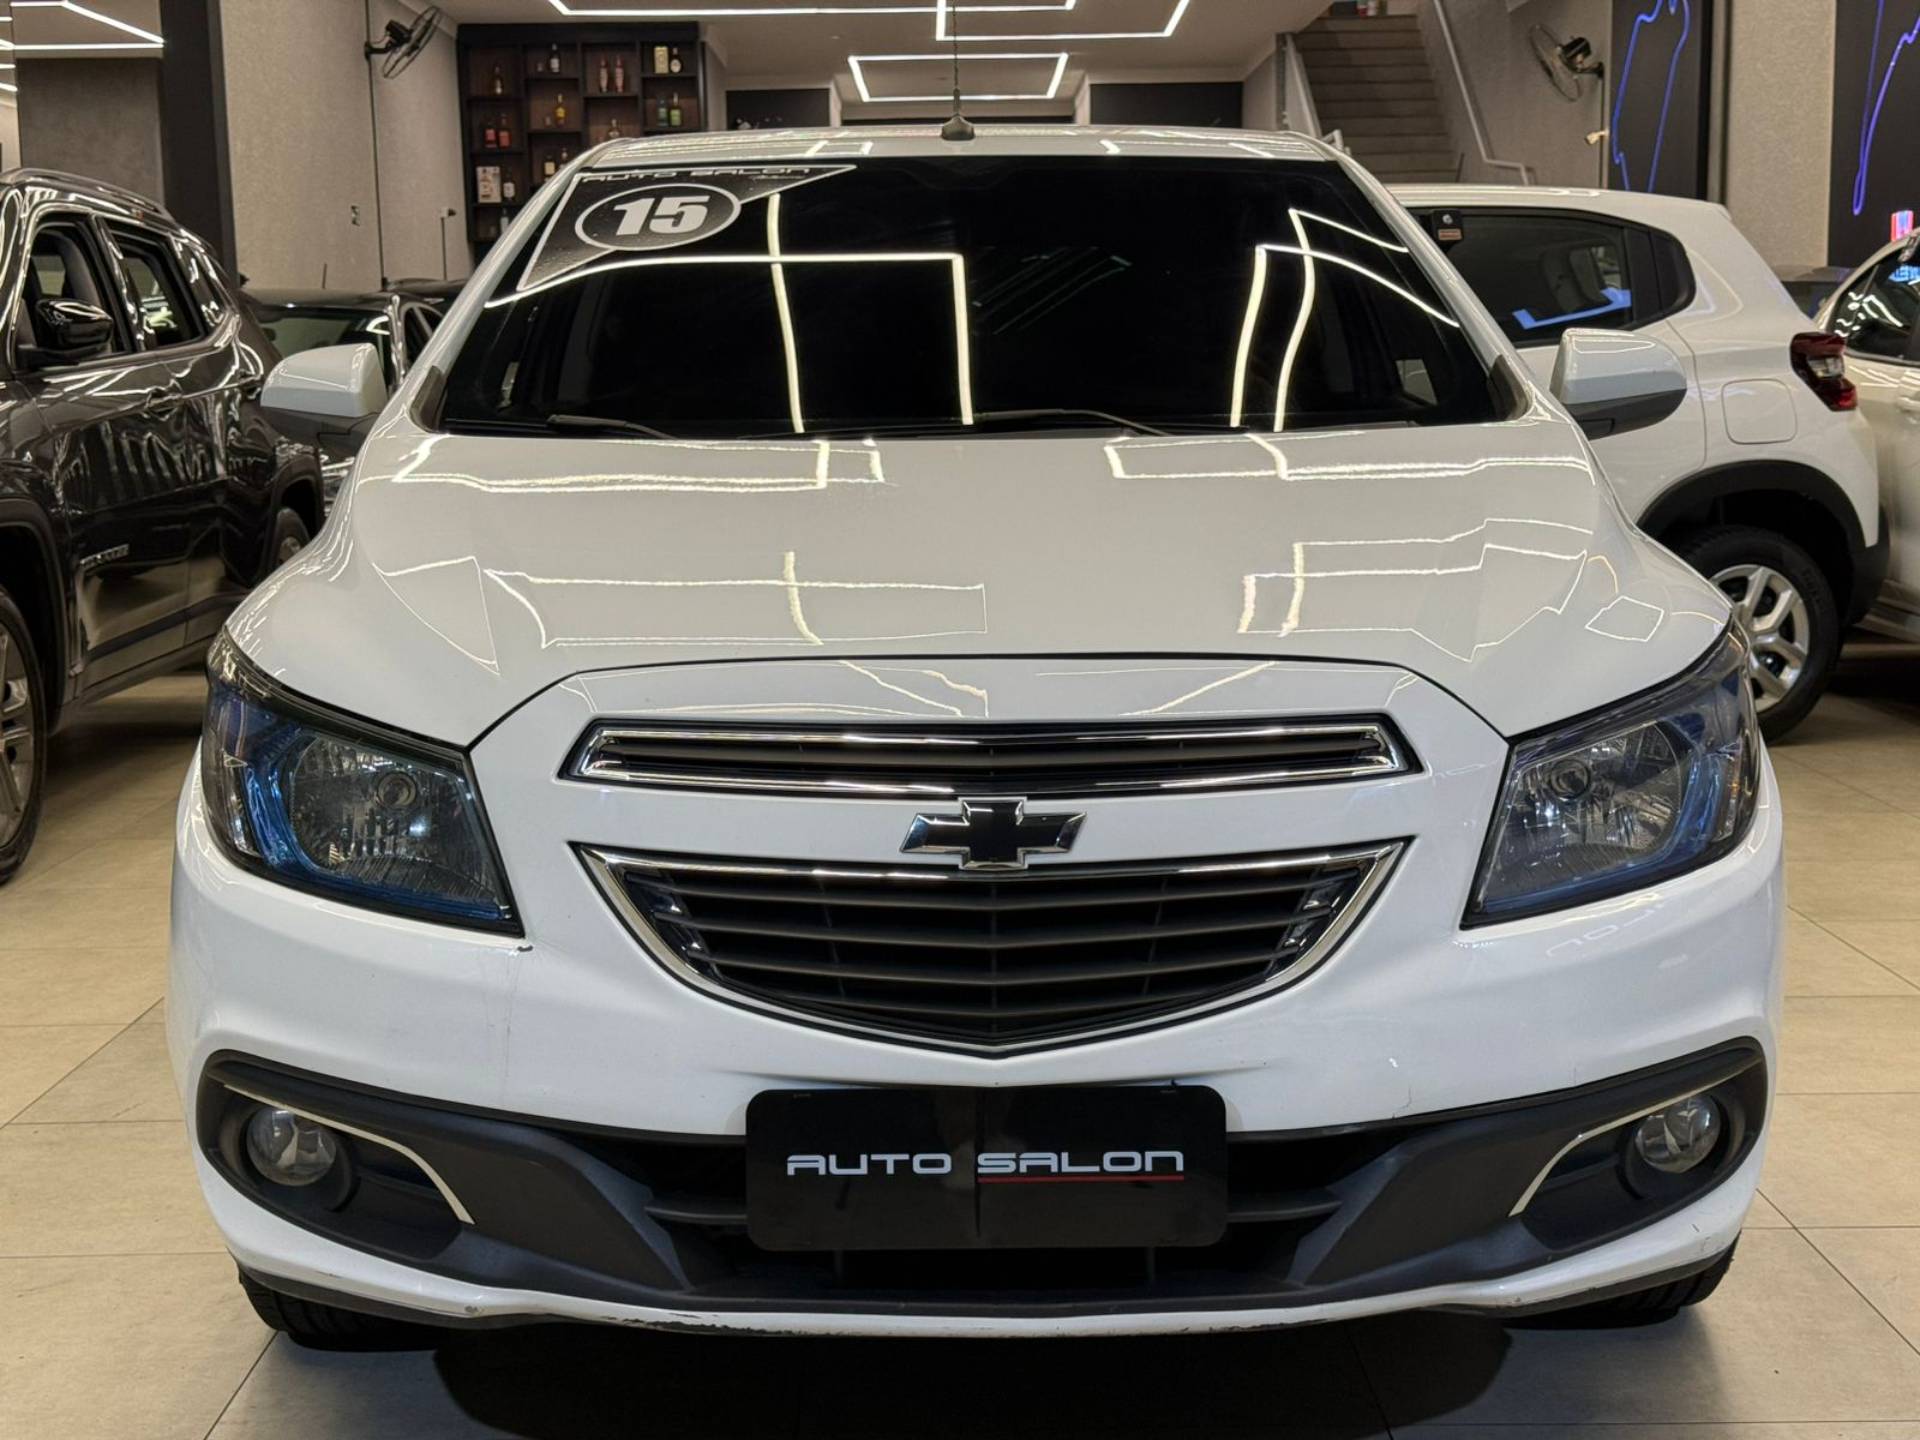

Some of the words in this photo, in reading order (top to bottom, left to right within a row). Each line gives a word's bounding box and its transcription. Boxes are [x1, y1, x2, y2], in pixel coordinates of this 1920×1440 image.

[613, 195, 710, 236] 15
[787, 1153, 952, 1176] AUTO
[977, 1151, 1184, 1174] SALON
